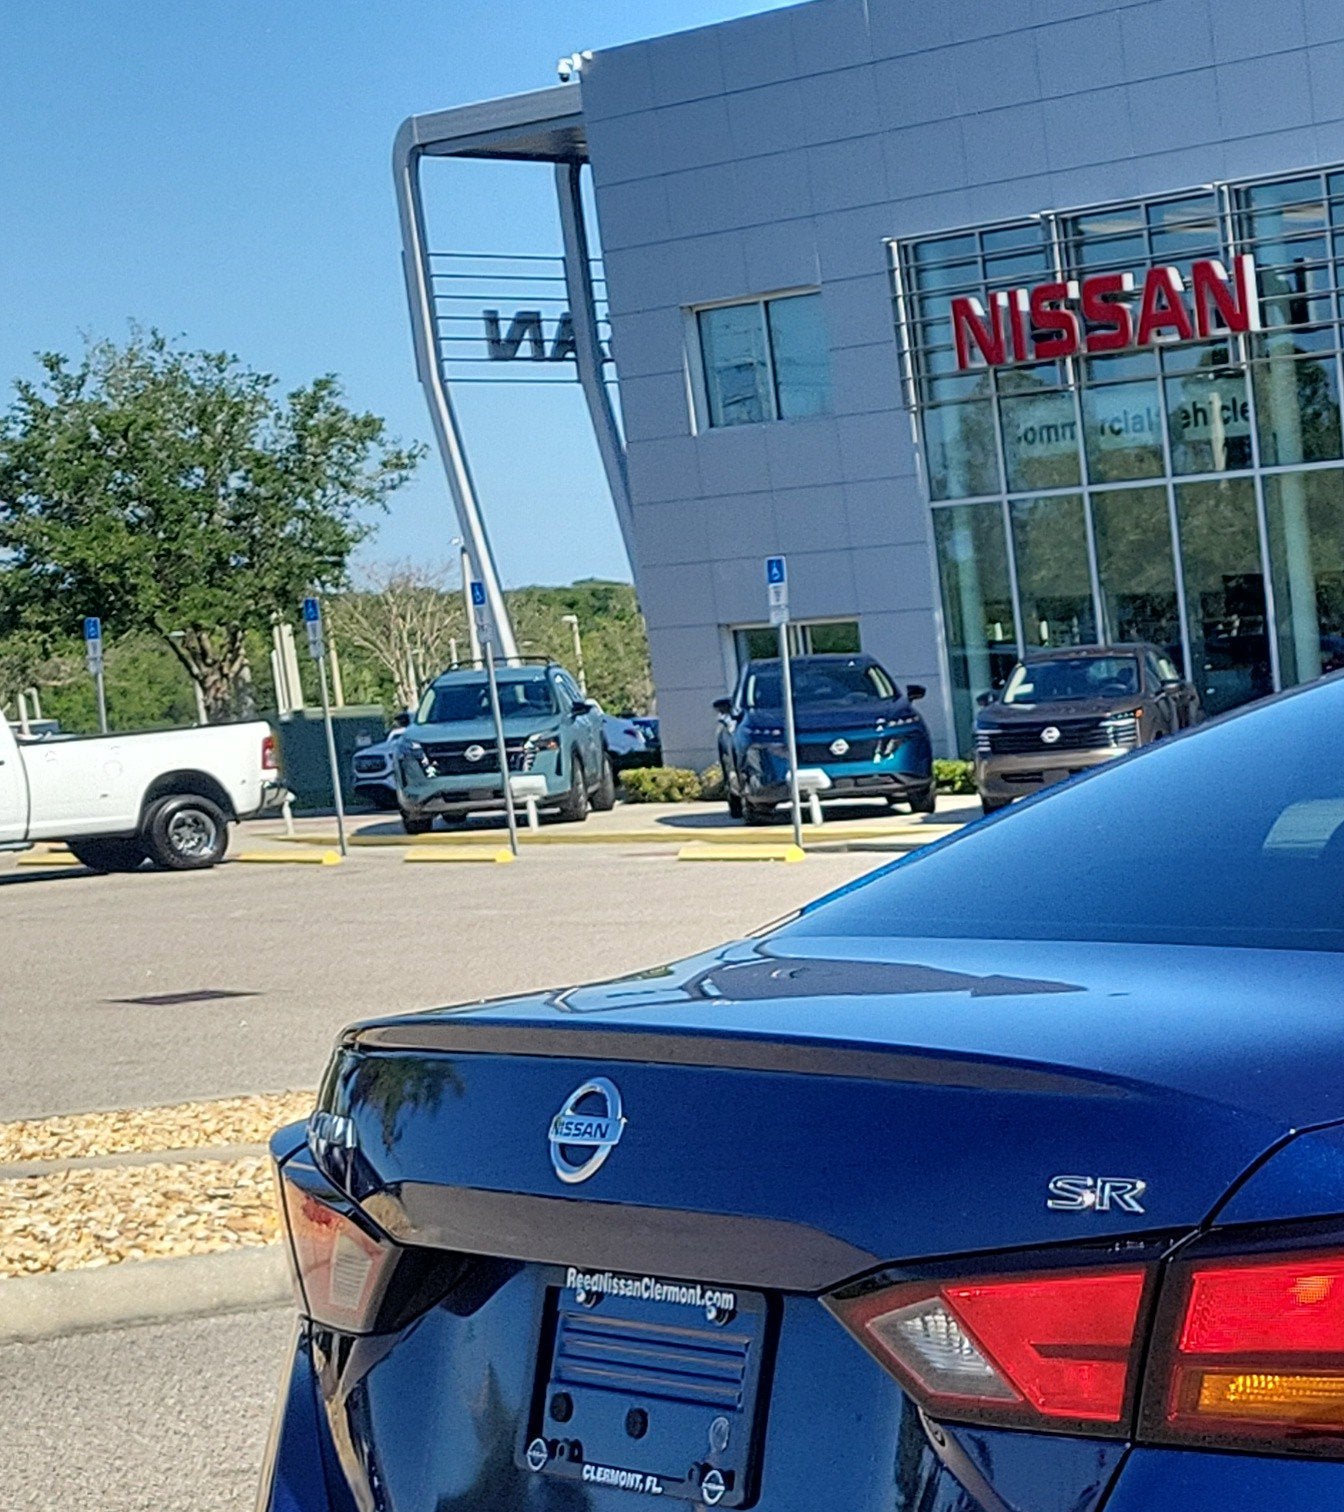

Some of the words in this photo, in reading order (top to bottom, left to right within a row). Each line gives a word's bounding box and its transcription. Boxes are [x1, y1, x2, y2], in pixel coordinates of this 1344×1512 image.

[952, 253, 1257, 371] NISSAN
[1046, 1174, 1146, 1213] SR
[566, 1266, 734, 1311] ReedNissanClermont.com
[582, 1464, 644, 1493] CLERMONT,
